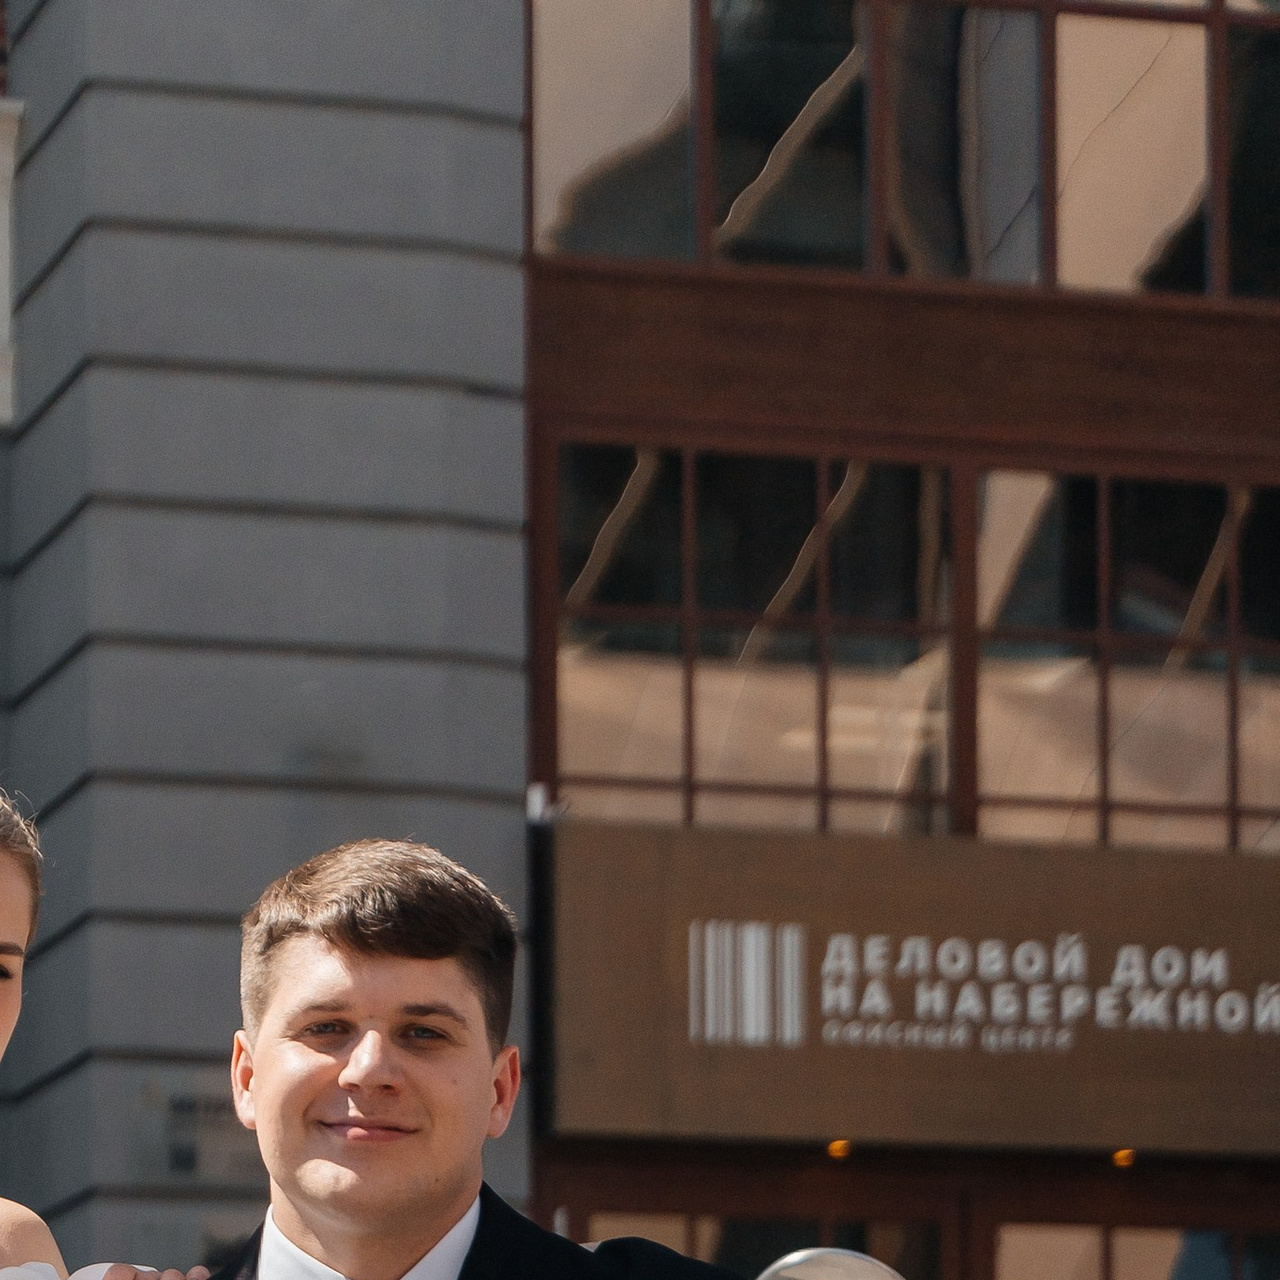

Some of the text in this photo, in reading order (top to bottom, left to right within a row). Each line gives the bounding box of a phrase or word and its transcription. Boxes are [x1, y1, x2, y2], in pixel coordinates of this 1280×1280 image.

[821, 933, 1230, 989] ДЕЛОВОЙ ДОМ
[821, 980, 1280, 1034] НА НАБЕРЕЖНОЙ
